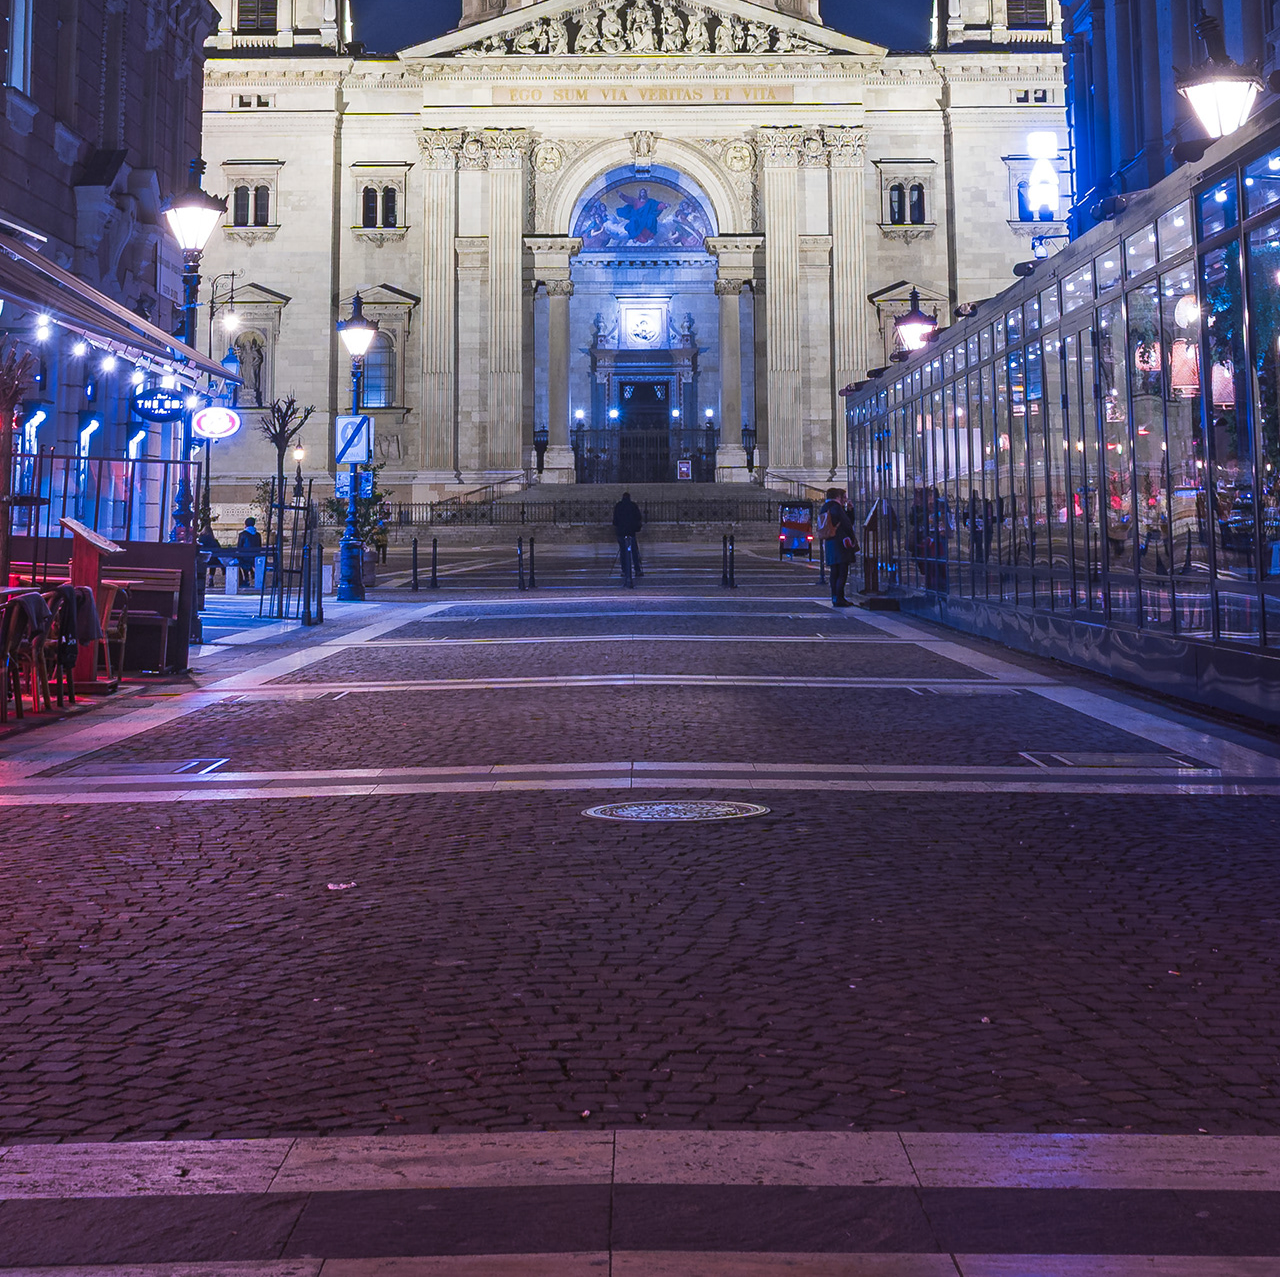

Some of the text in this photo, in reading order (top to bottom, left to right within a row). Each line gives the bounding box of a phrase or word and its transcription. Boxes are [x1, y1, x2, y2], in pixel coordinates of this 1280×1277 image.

[509, 87, 776, 101] EGO SUM VIA VERITAS ET VITA
